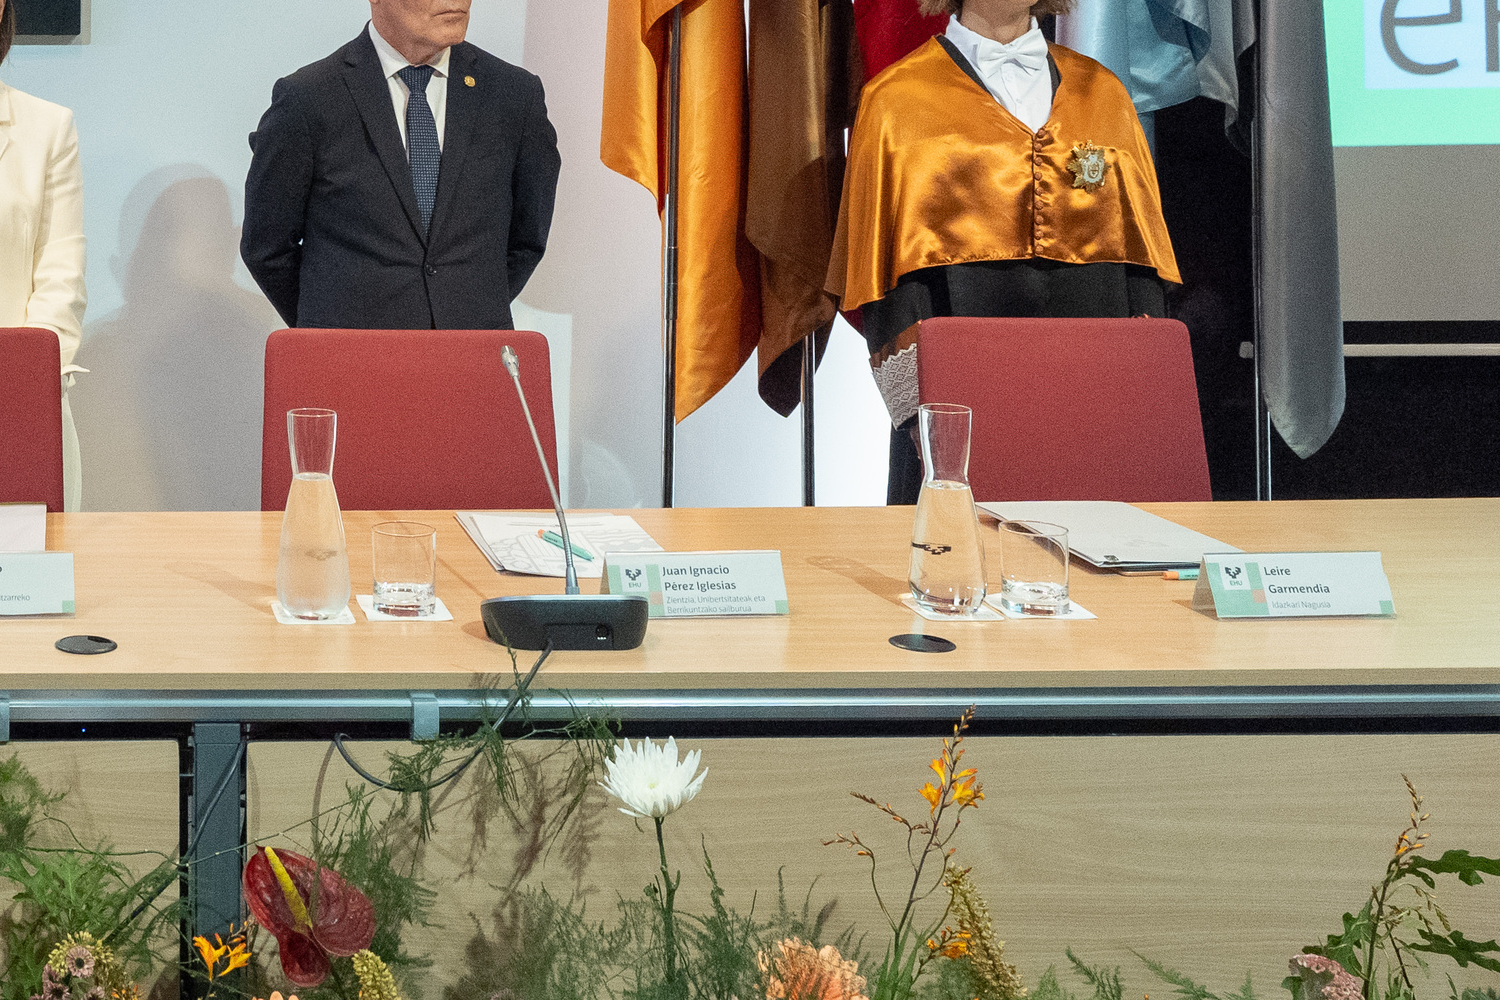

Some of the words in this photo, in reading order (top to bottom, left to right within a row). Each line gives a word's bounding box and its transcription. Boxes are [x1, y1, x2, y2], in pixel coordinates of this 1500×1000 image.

[662, 566, 687, 576] Juan
[689, 565, 730, 577] Ignacio
[1263, 566, 1291, 576] Leire
[664, 581, 695, 591] Pérez
[696, 580, 737, 592] Iglesias
[1268, 584, 1331, 594] Garmendia
[1301, 600, 1332, 610] Nagusia
